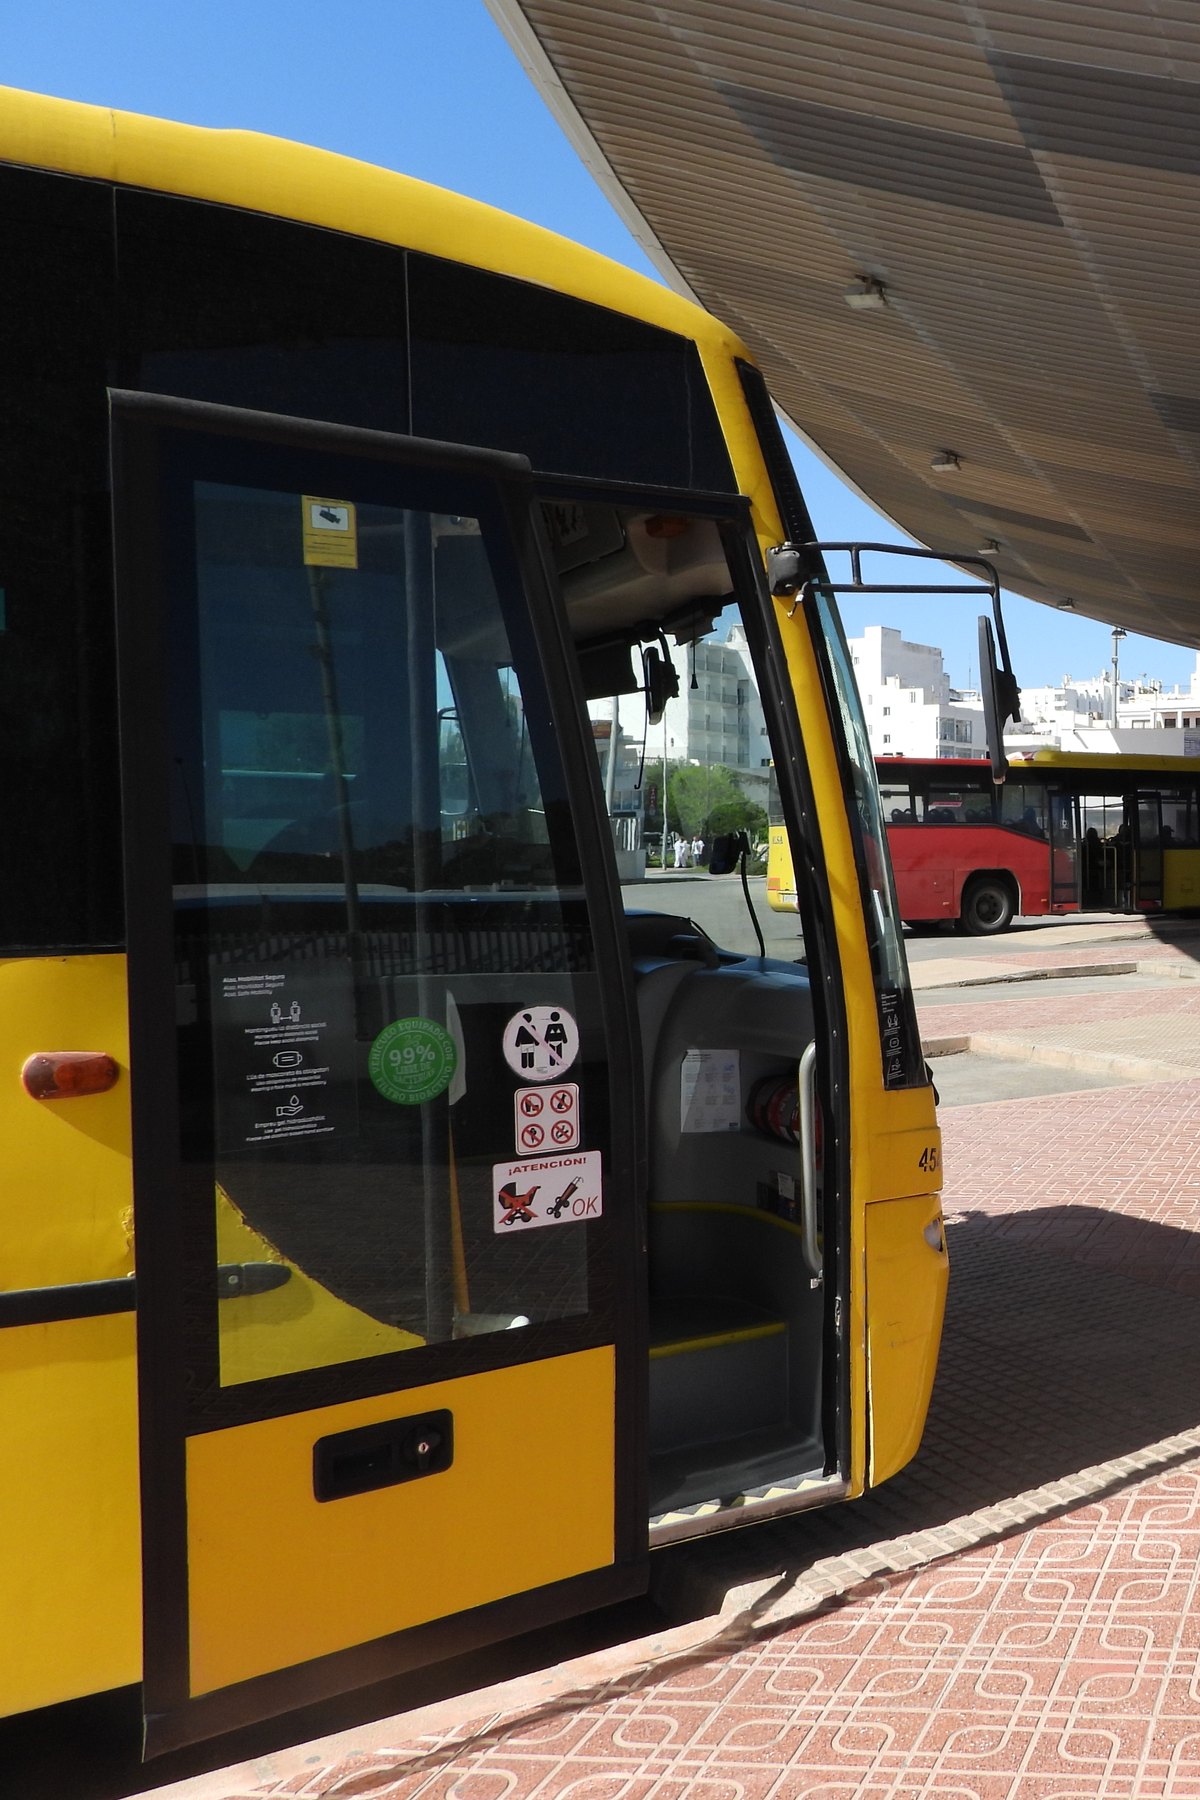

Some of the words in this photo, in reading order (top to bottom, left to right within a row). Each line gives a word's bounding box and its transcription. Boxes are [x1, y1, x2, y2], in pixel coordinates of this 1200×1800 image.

[398, 1020, 445, 1041] EQUIPADO
[442, 1040, 454, 1060] CON
[388, 1043, 436, 1067] 99%
[508, 1157, 587, 1176] ¡ATENCIÓN!
[572, 1195, 600, 1217] OK
